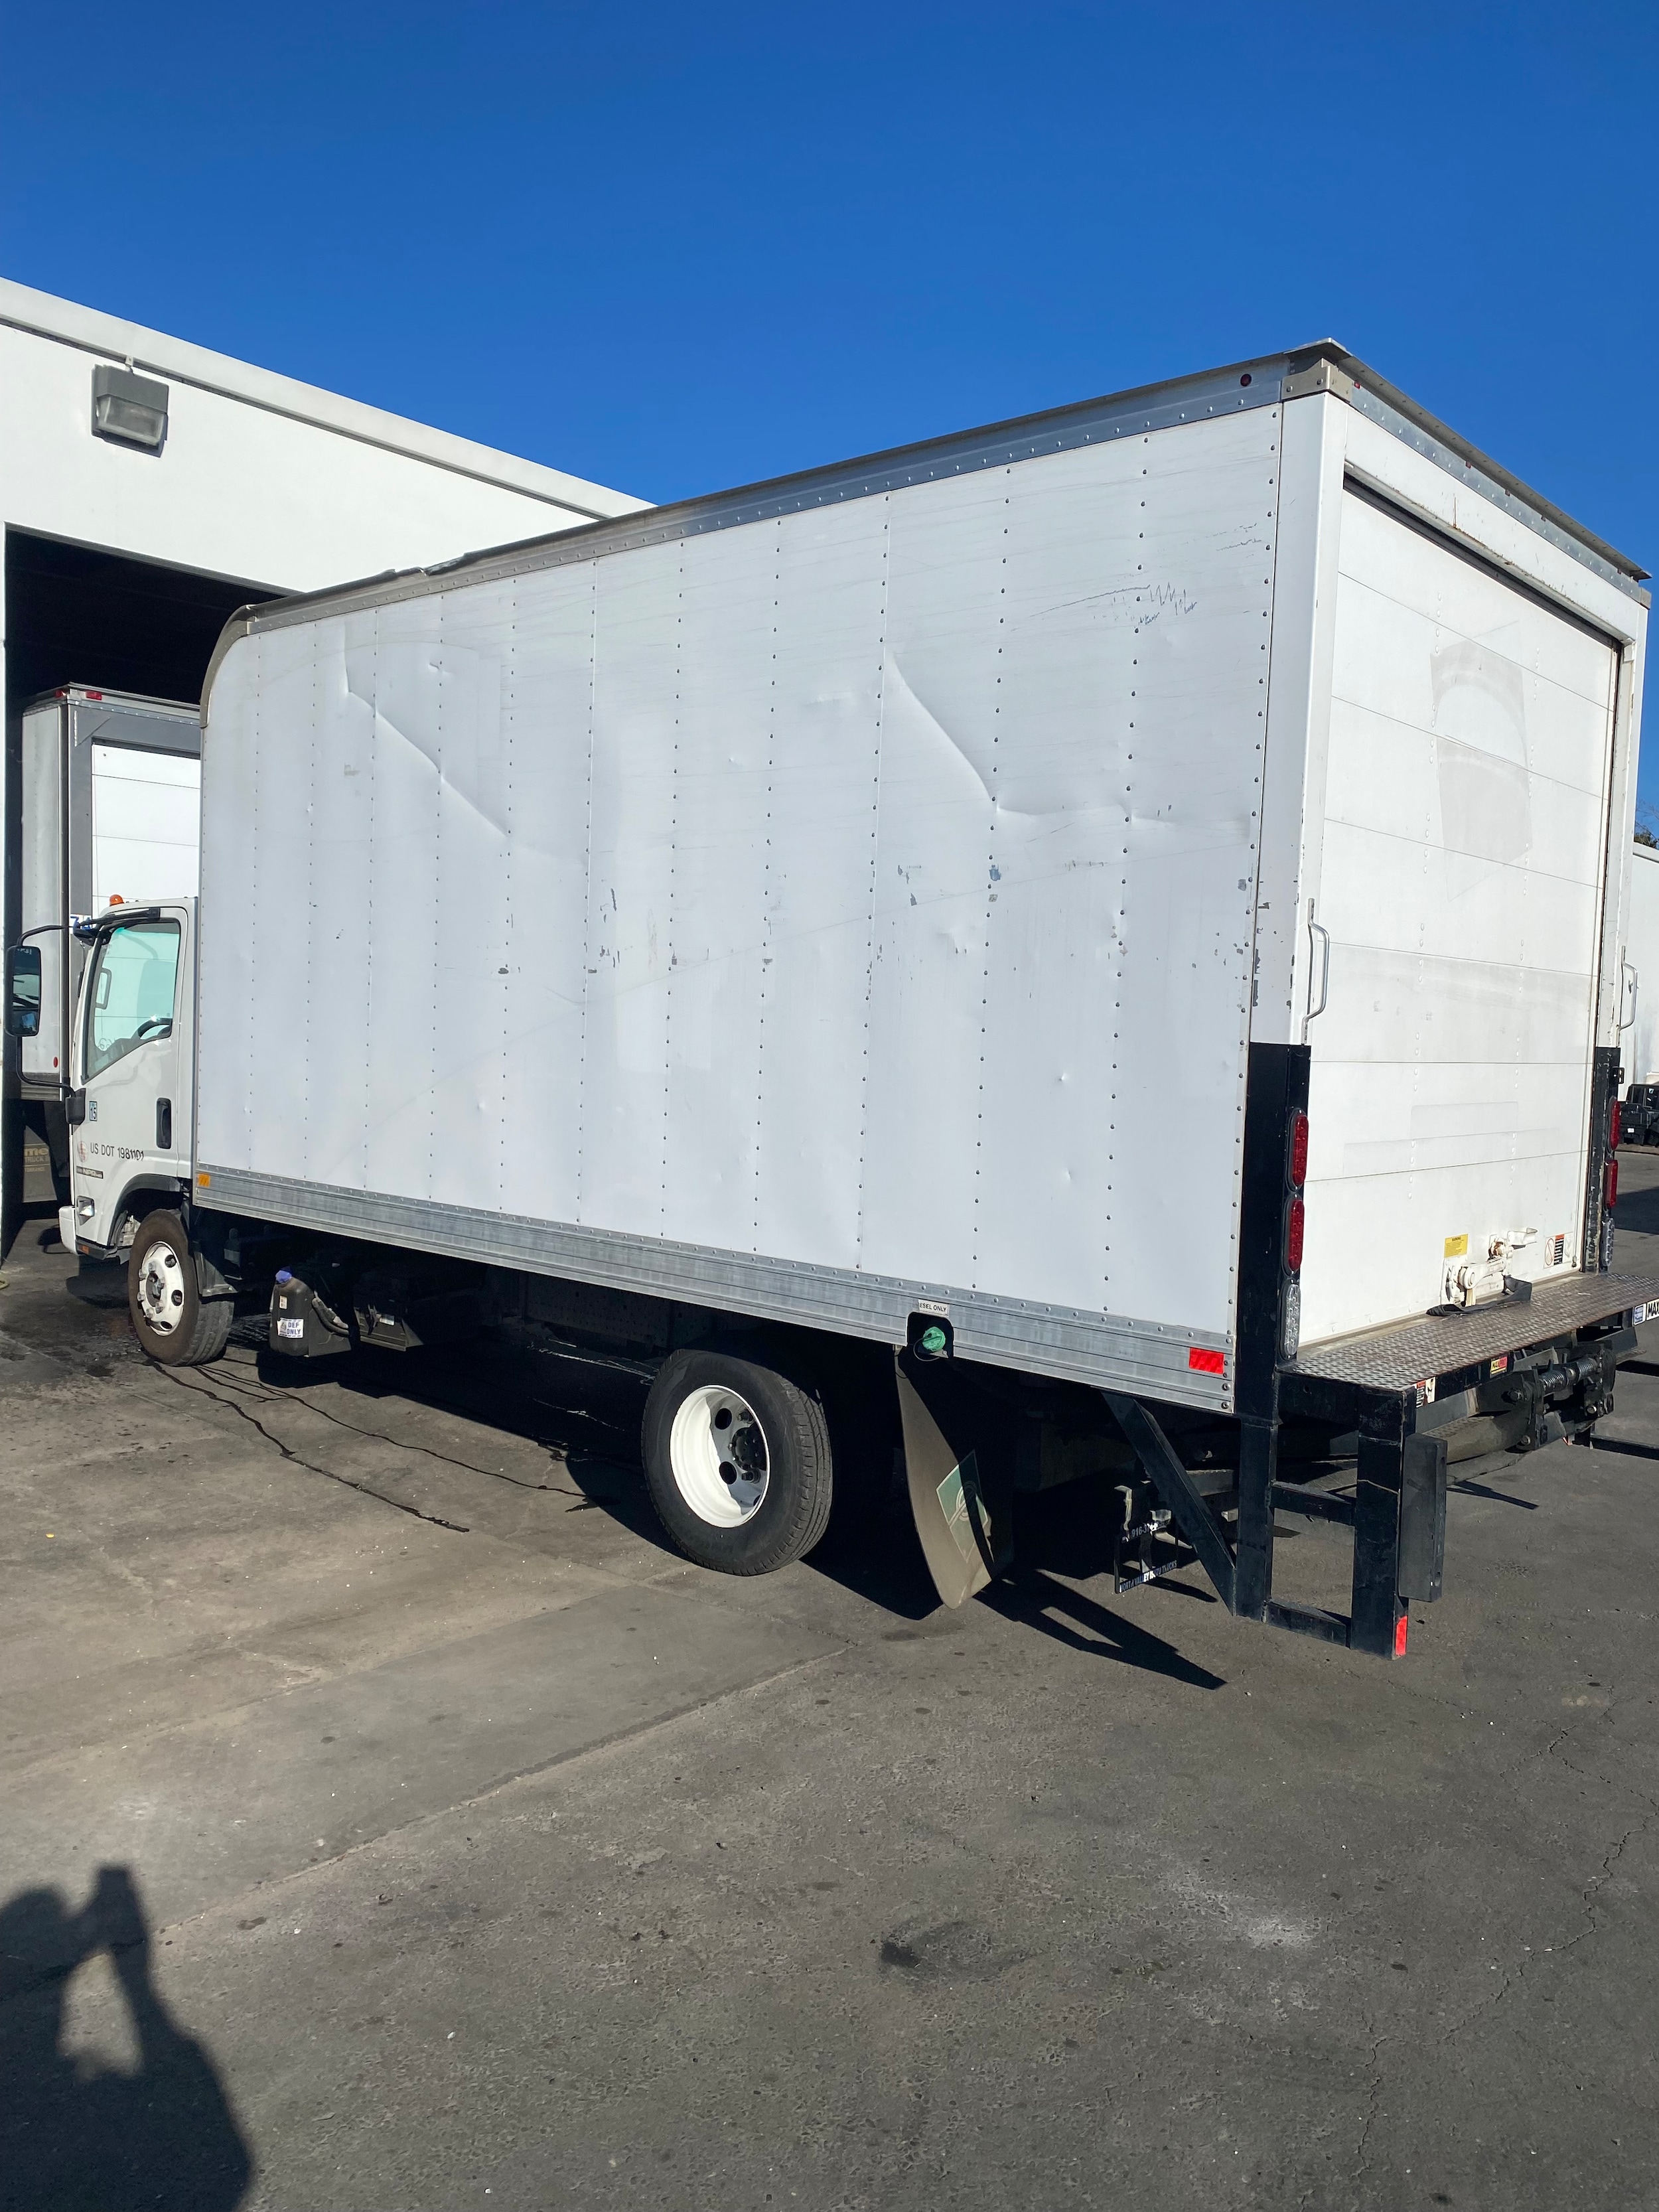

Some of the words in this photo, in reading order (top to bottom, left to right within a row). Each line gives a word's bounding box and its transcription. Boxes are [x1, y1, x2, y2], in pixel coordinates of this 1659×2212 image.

[90, 1108, 97, 1120] 15
[90, 1142, 98, 1154] US
[102, 1144, 114, 1157] DOT
[117, 1147, 144, 1161] 1981101
